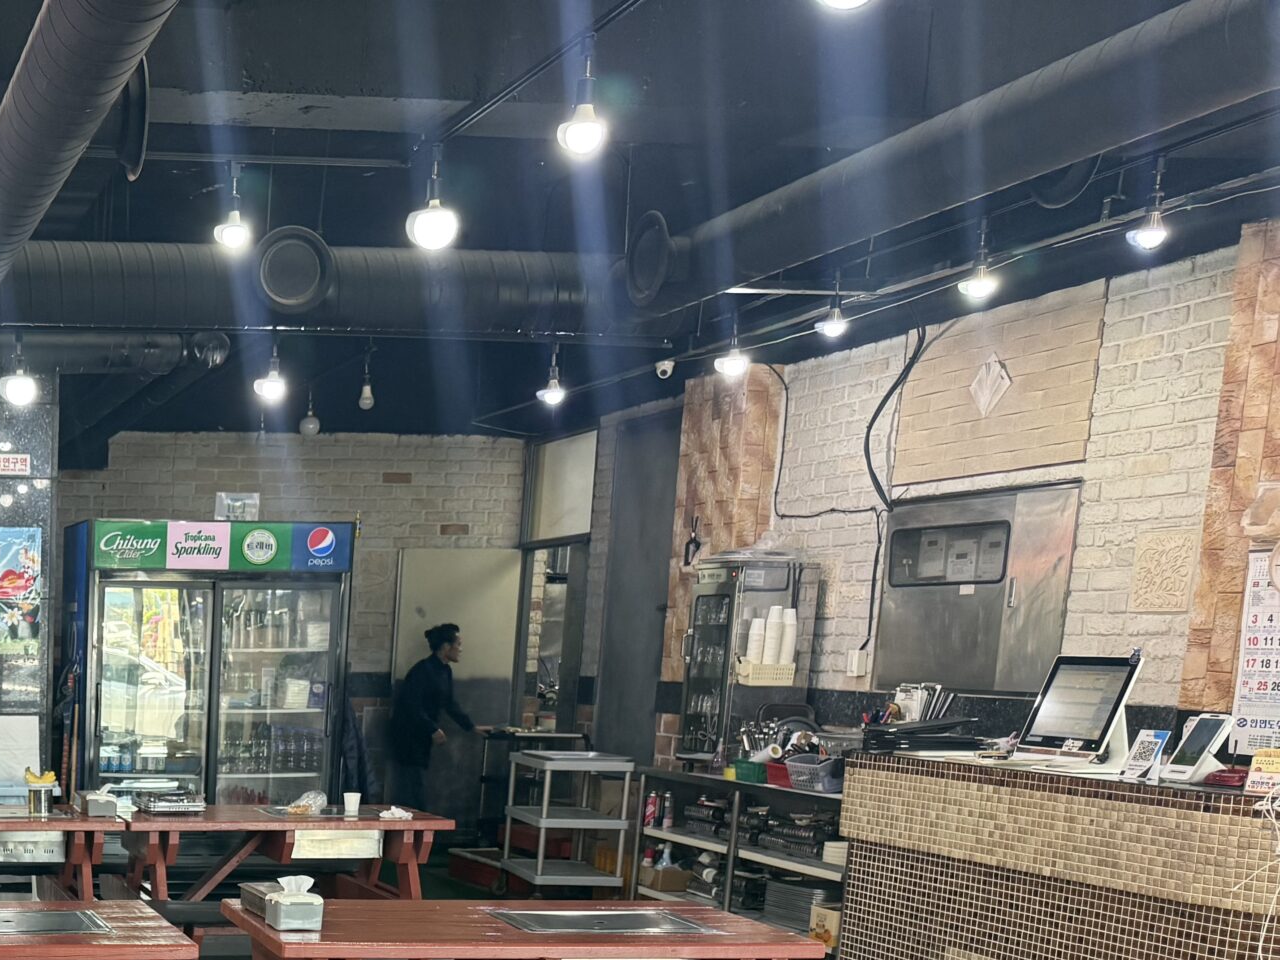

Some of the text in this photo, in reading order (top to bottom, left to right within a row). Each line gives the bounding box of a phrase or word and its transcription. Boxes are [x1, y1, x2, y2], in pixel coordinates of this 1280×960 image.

[184, 531, 216, 543] Tropicana
[99, 531, 161, 556] Chilsung
[117, 549, 142, 560] Cider
[171, 543, 222, 559] Sparkling
[308, 557, 334, 566] pepsi
[1251, 613, 1273, 624] 3 4
[1247, 636, 1274, 646] 10 11
[1246, 658, 1257, 668] 17
[1260, 658, 1271, 668] 18
[1256, 681, 1268, 691] 25
